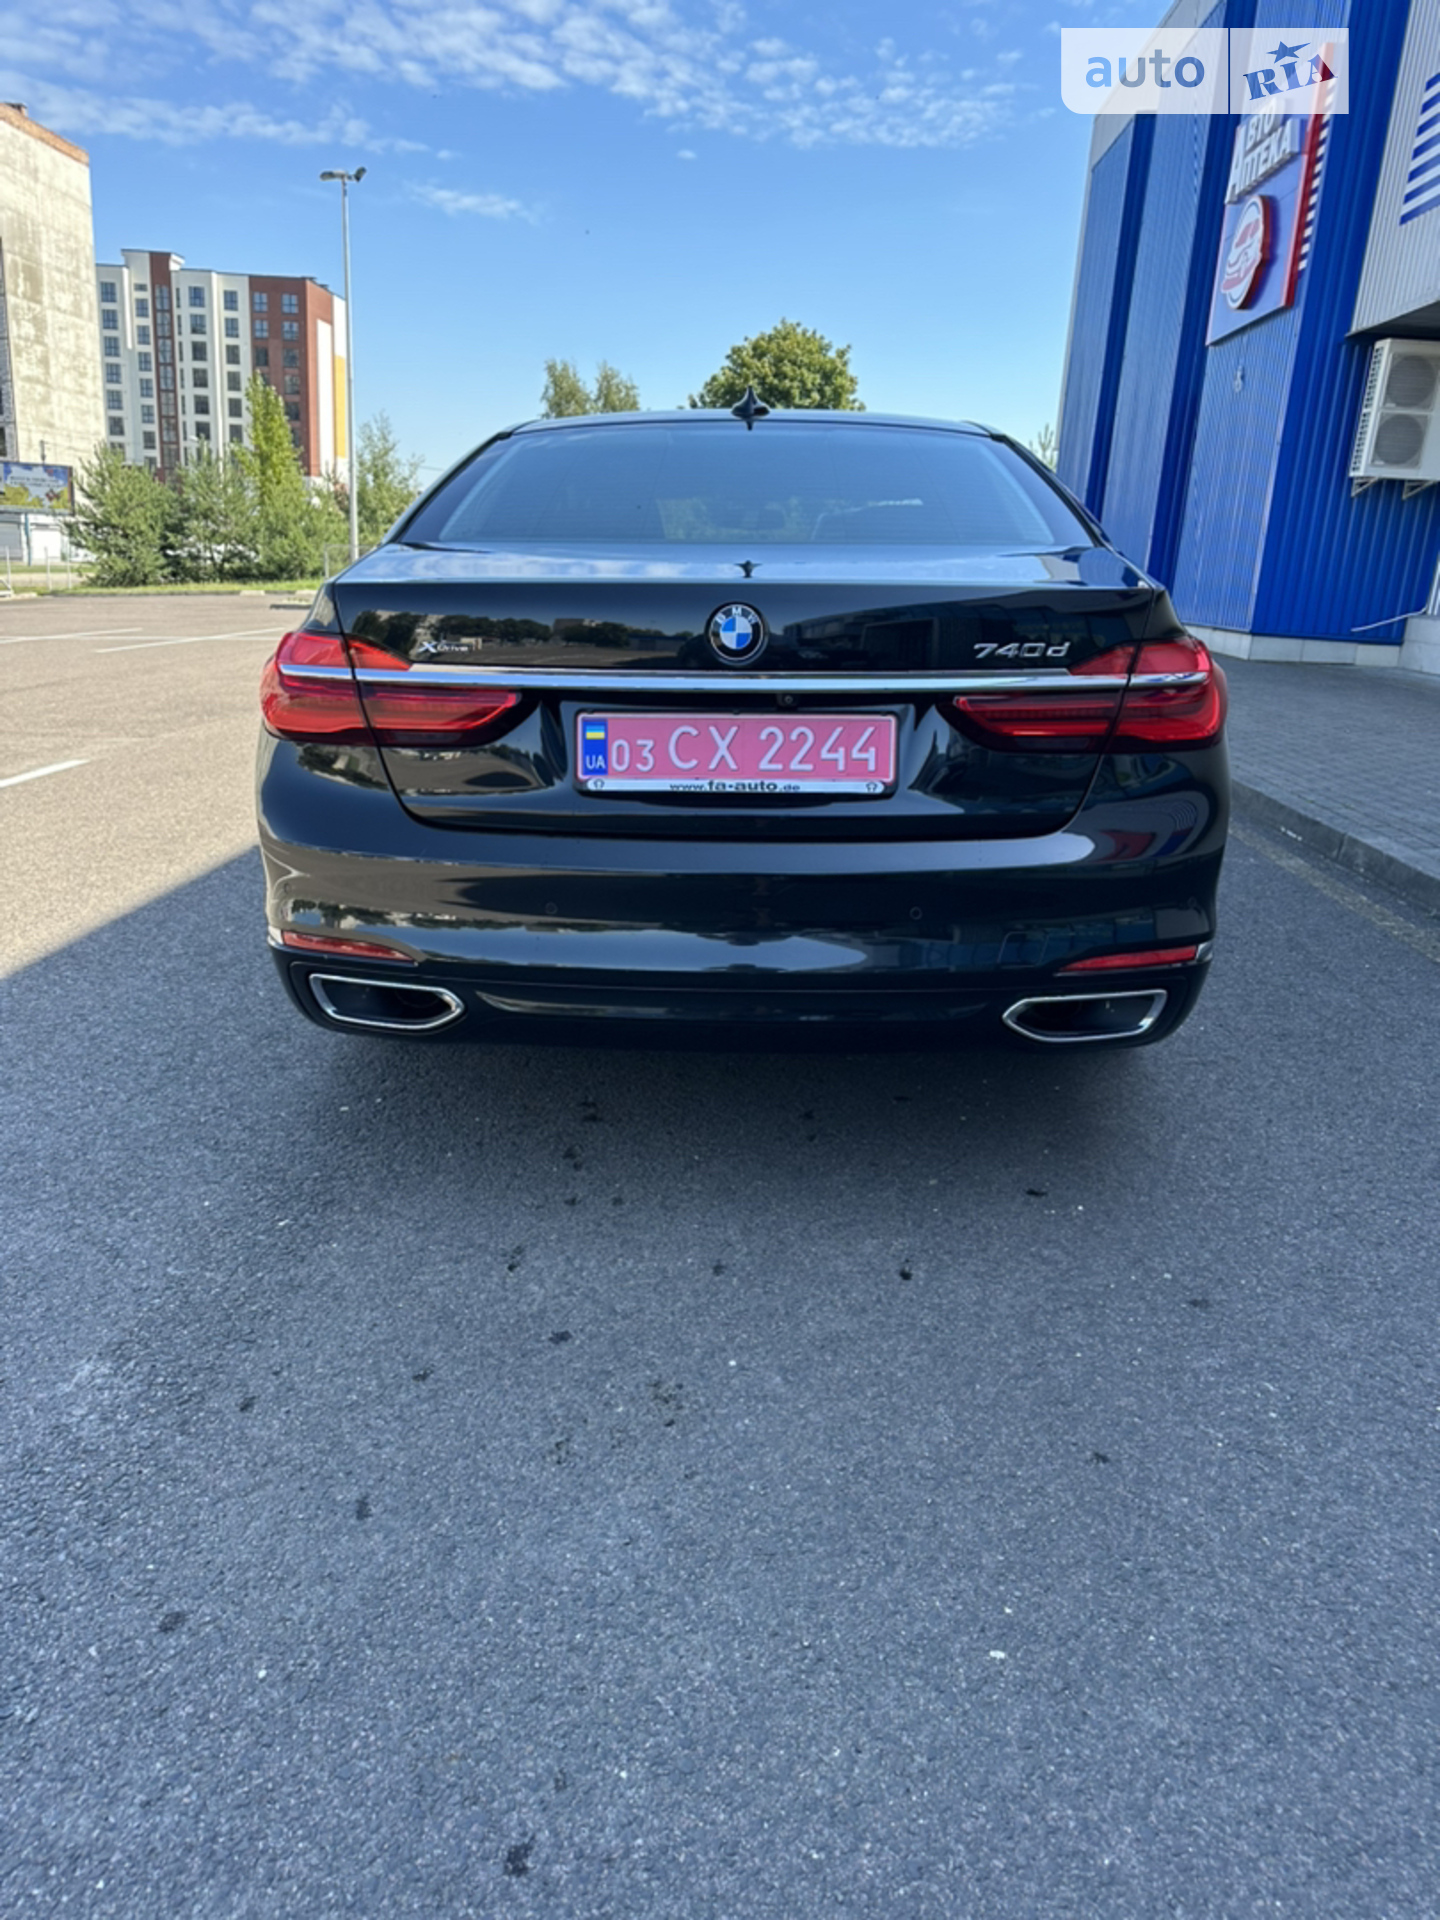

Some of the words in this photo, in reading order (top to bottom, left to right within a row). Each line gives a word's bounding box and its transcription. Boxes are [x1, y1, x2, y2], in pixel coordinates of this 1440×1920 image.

[973, 641, 1070, 659] 740d
[611, 739, 654, 772] 03
[667, 725, 738, 771] CX
[758, 726, 876, 771] 2244
[585, 754, 605, 769] UA
